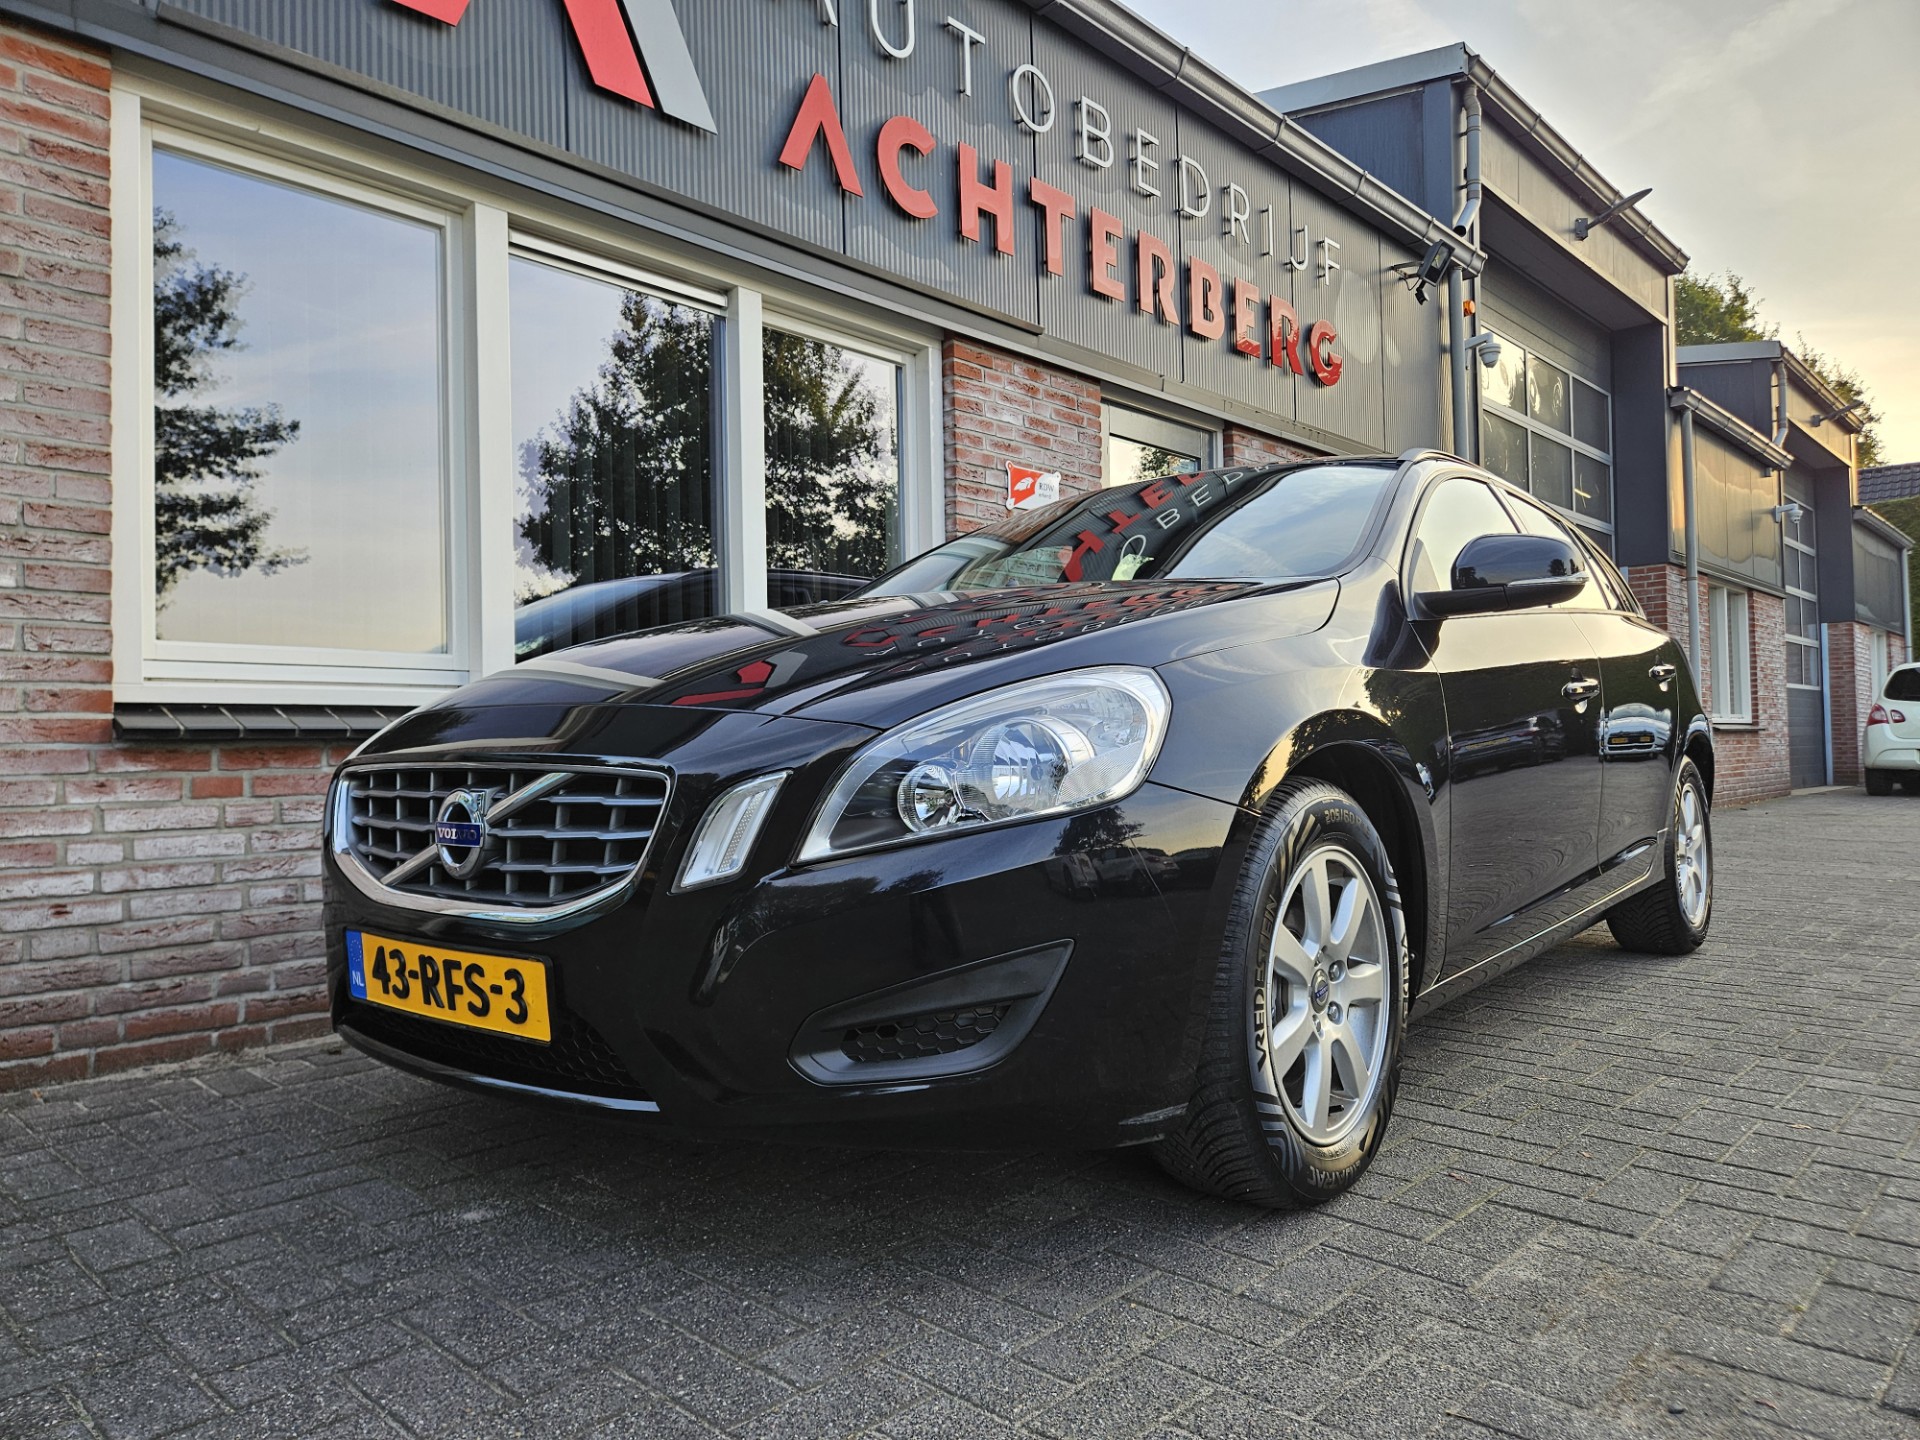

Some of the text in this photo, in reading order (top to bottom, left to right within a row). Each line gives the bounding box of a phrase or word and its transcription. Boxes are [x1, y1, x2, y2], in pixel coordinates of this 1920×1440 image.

[779, 73, 1343, 387] ACHTERBERG
[824, 0, 1340, 286] UTOBEDRIJF
[352, 970, 365, 988] NL
[371, 945, 529, 1025] 43-RFS-3
[1253, 894, 1278, 1072] VREDESTEIN
